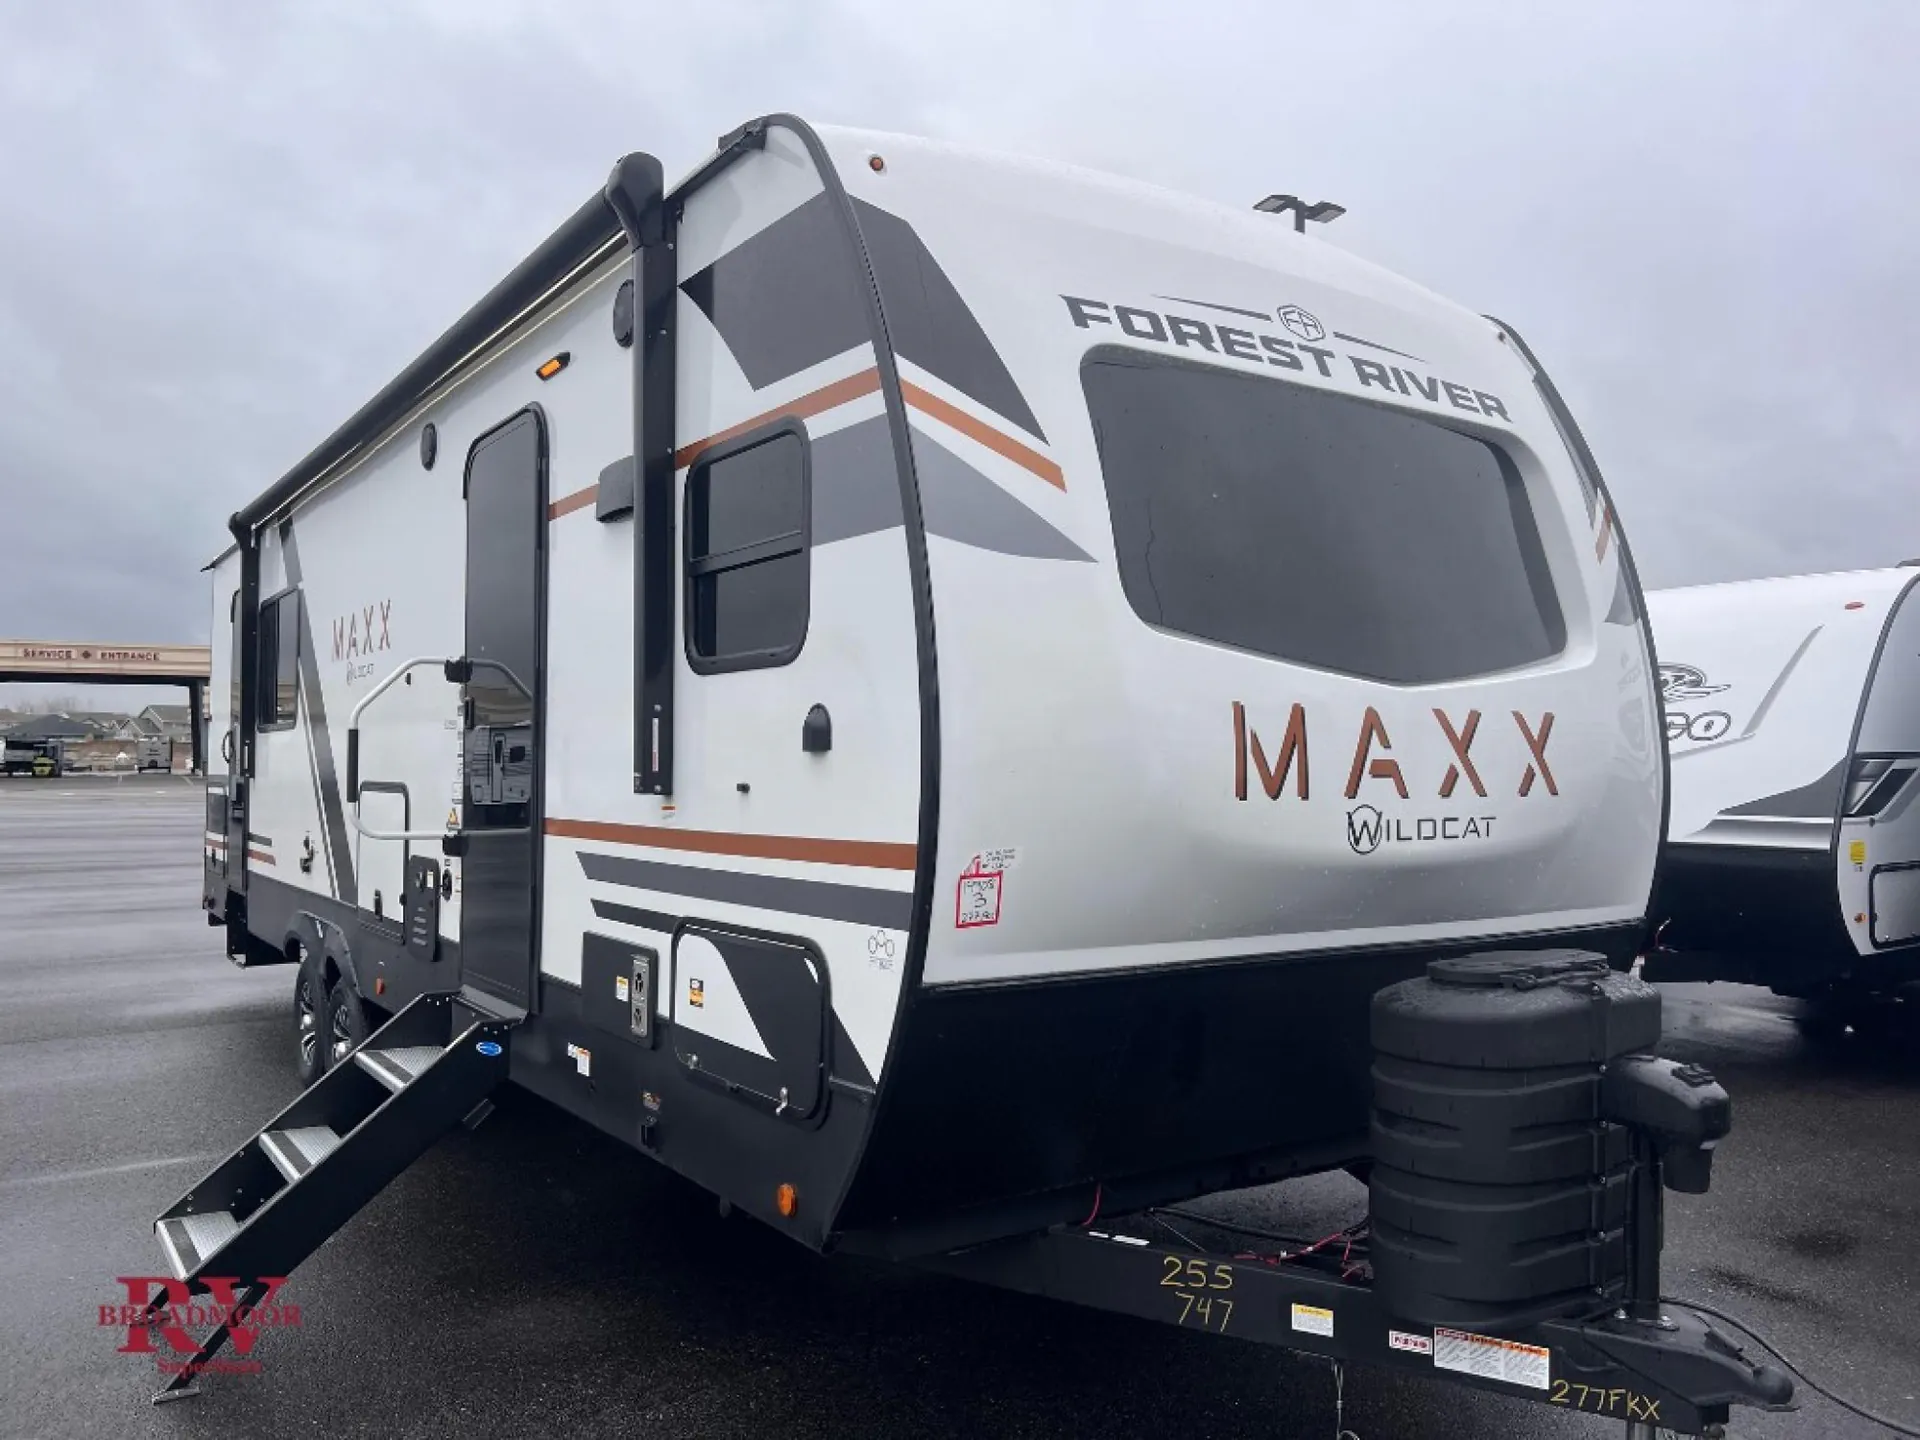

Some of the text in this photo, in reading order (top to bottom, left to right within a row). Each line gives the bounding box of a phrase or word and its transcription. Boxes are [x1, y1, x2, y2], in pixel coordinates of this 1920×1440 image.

[1058, 294, 1511, 423] FOREST RIVER
[331, 598, 391, 662] MAXX
[100, 651, 160, 661] ENTRANCE
[1232, 700, 1559, 801] MAXX
[1346, 804, 1497, 855] WILDCAT
[1160, 1255, 1234, 1289] 255
[1175, 1291, 1233, 1332] 747
